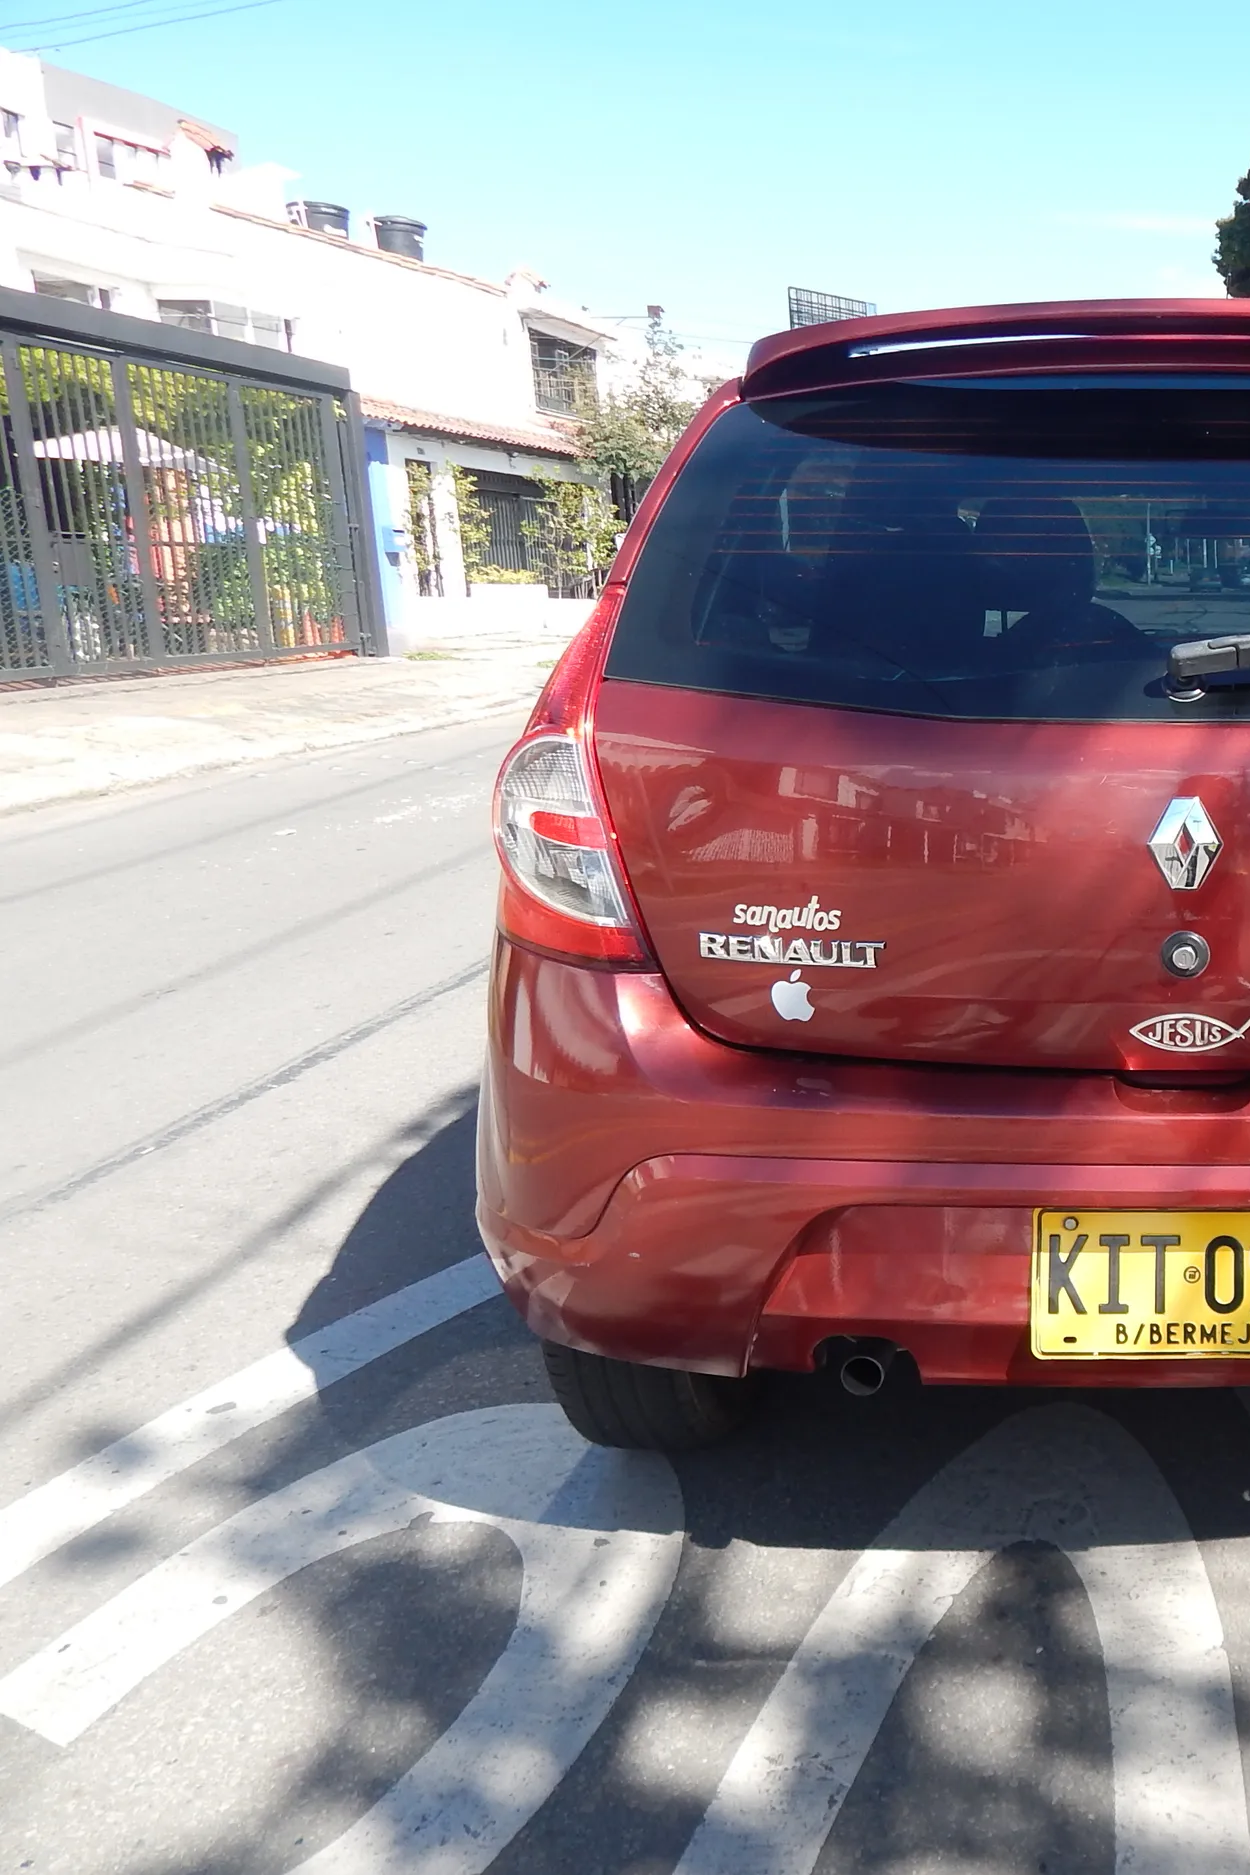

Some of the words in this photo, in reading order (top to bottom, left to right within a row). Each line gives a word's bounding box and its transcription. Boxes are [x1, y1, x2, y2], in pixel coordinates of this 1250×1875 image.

[733, 895, 842, 933] sanautos
[699, 932, 887, 968] RENAULT
[1148, 1019, 1222, 1047] JESUS
[1047, 1233, 1182, 1315] KIT
